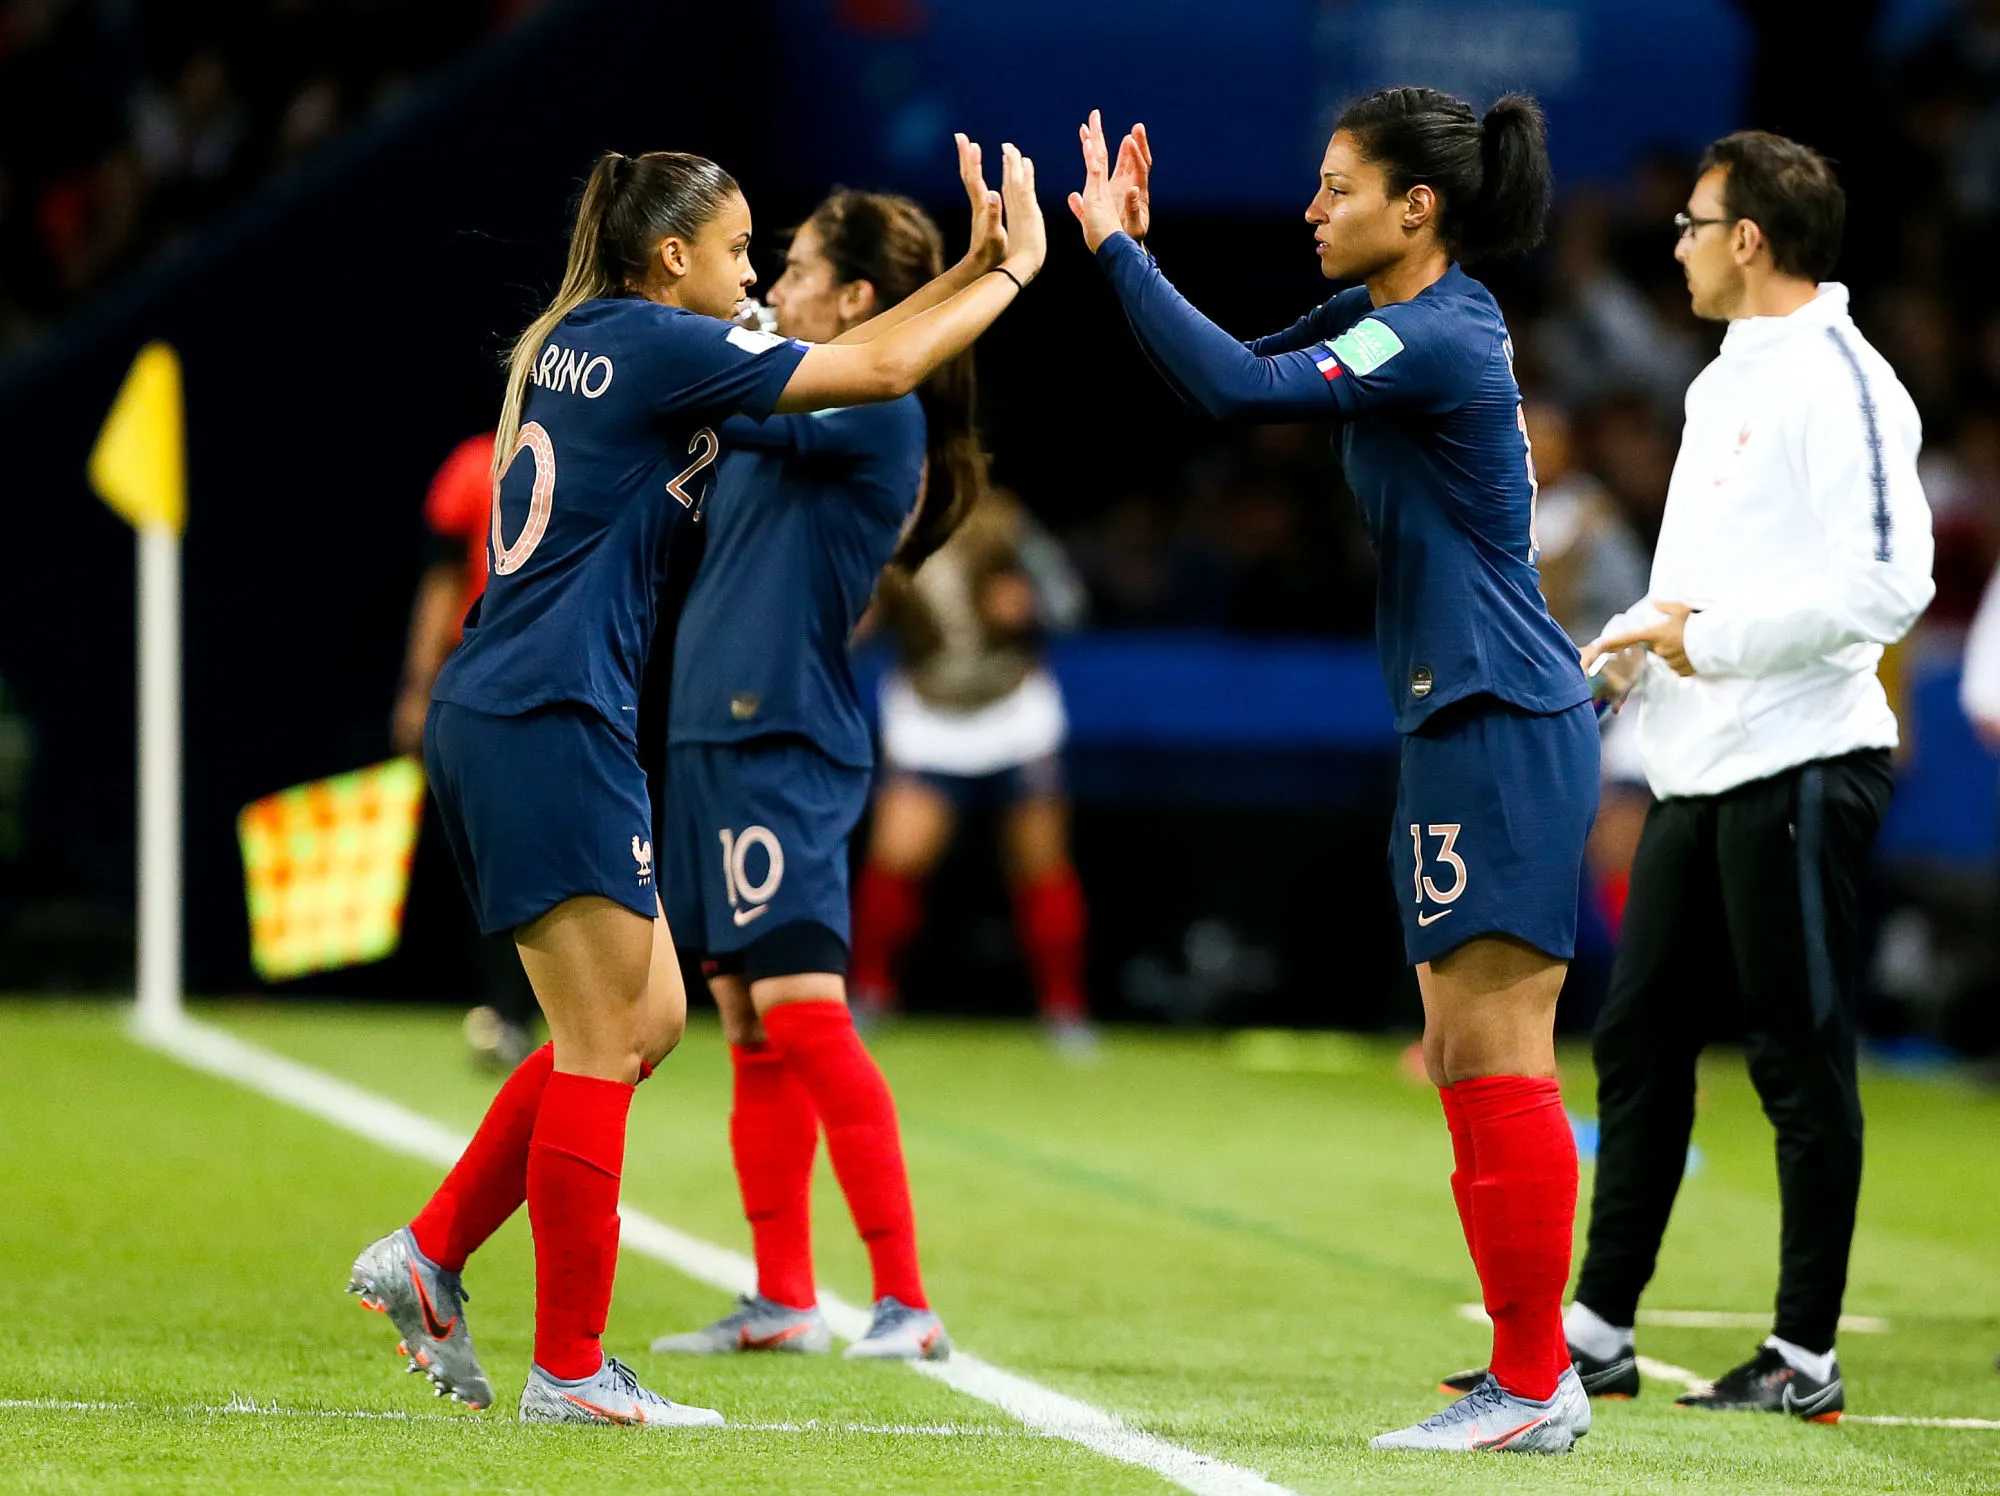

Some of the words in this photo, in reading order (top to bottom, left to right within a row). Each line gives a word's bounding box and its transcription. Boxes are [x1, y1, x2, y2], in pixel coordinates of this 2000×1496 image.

[485, 420, 556, 575] 0
[666, 427, 719, 522] 2
[718, 825, 785, 908] 10
[1410, 823, 1467, 904] 13
